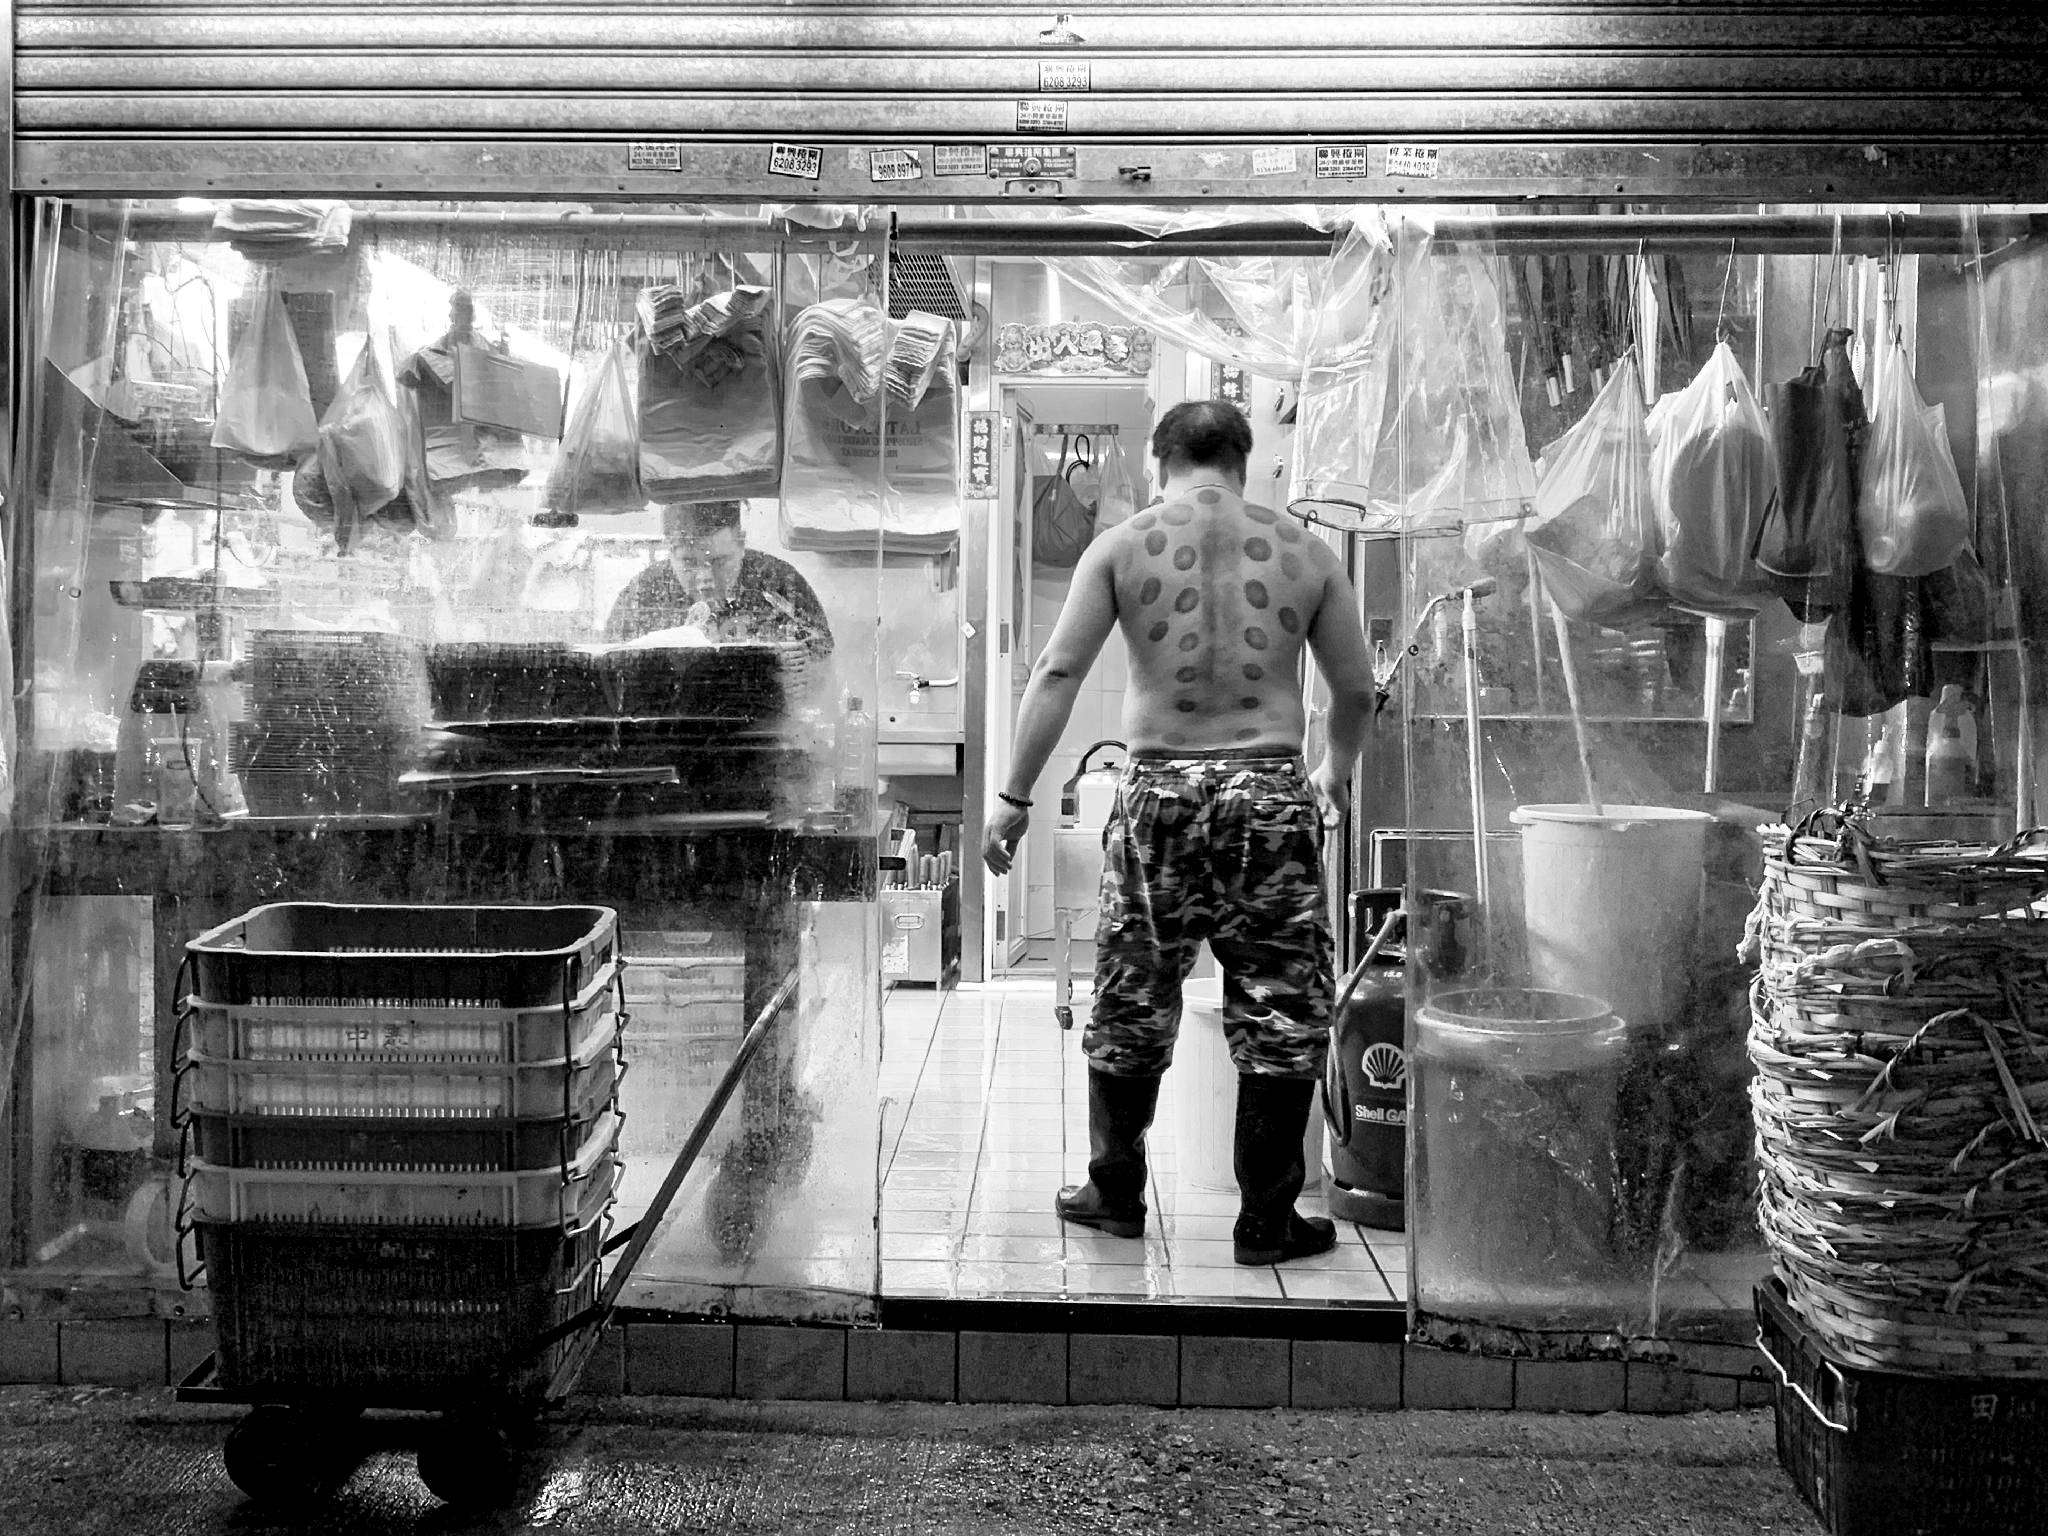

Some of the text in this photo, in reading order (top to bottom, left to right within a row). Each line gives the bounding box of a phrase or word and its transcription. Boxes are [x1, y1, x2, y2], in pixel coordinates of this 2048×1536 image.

[1043, 76, 1088, 88] 6208 3293
[773, 157, 795, 170] 6208
[795, 160, 817, 173] 3293
[878, 163, 896, 179] 9608
[1356, 1105, 1385, 1120] Shell
